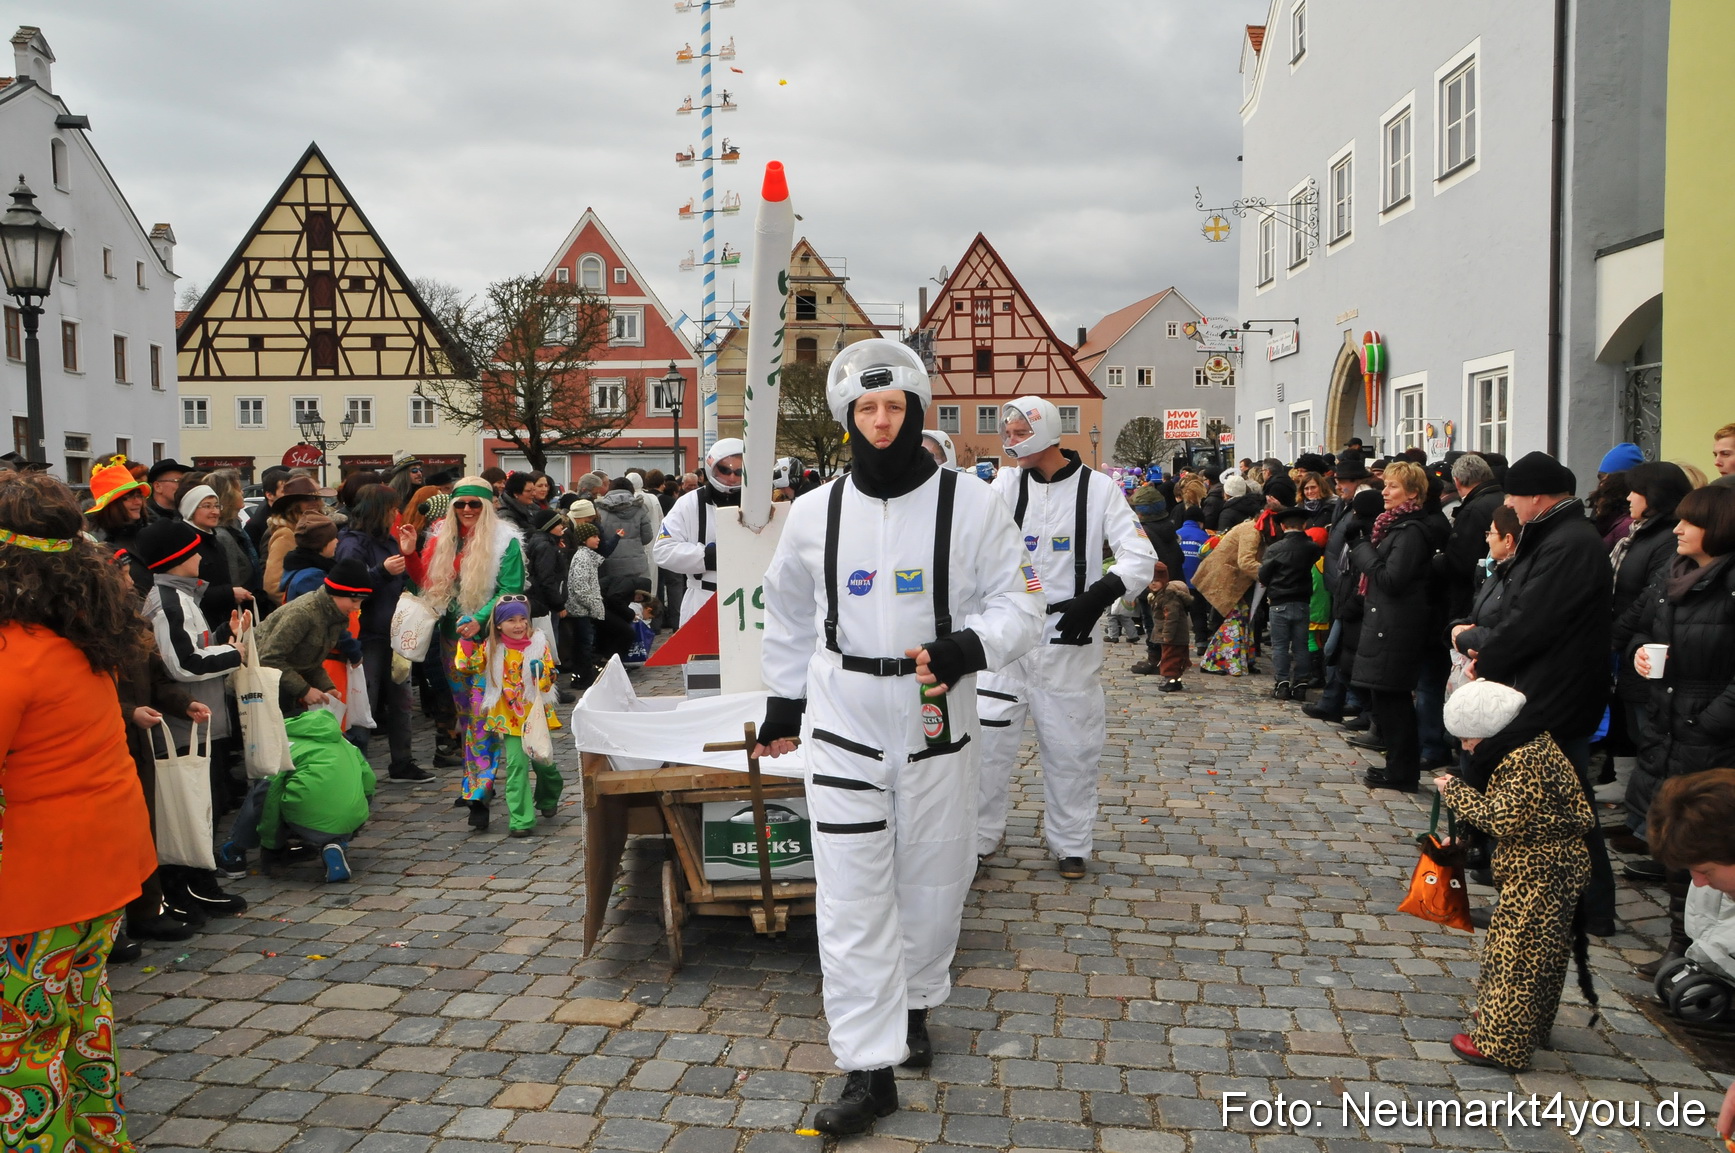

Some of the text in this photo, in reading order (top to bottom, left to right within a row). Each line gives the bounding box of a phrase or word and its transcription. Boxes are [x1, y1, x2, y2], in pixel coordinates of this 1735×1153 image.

[1166, 419, 1199, 430] ARCHE
[291, 451, 324, 466] Splash
[732, 839, 801, 855] BEK'S
